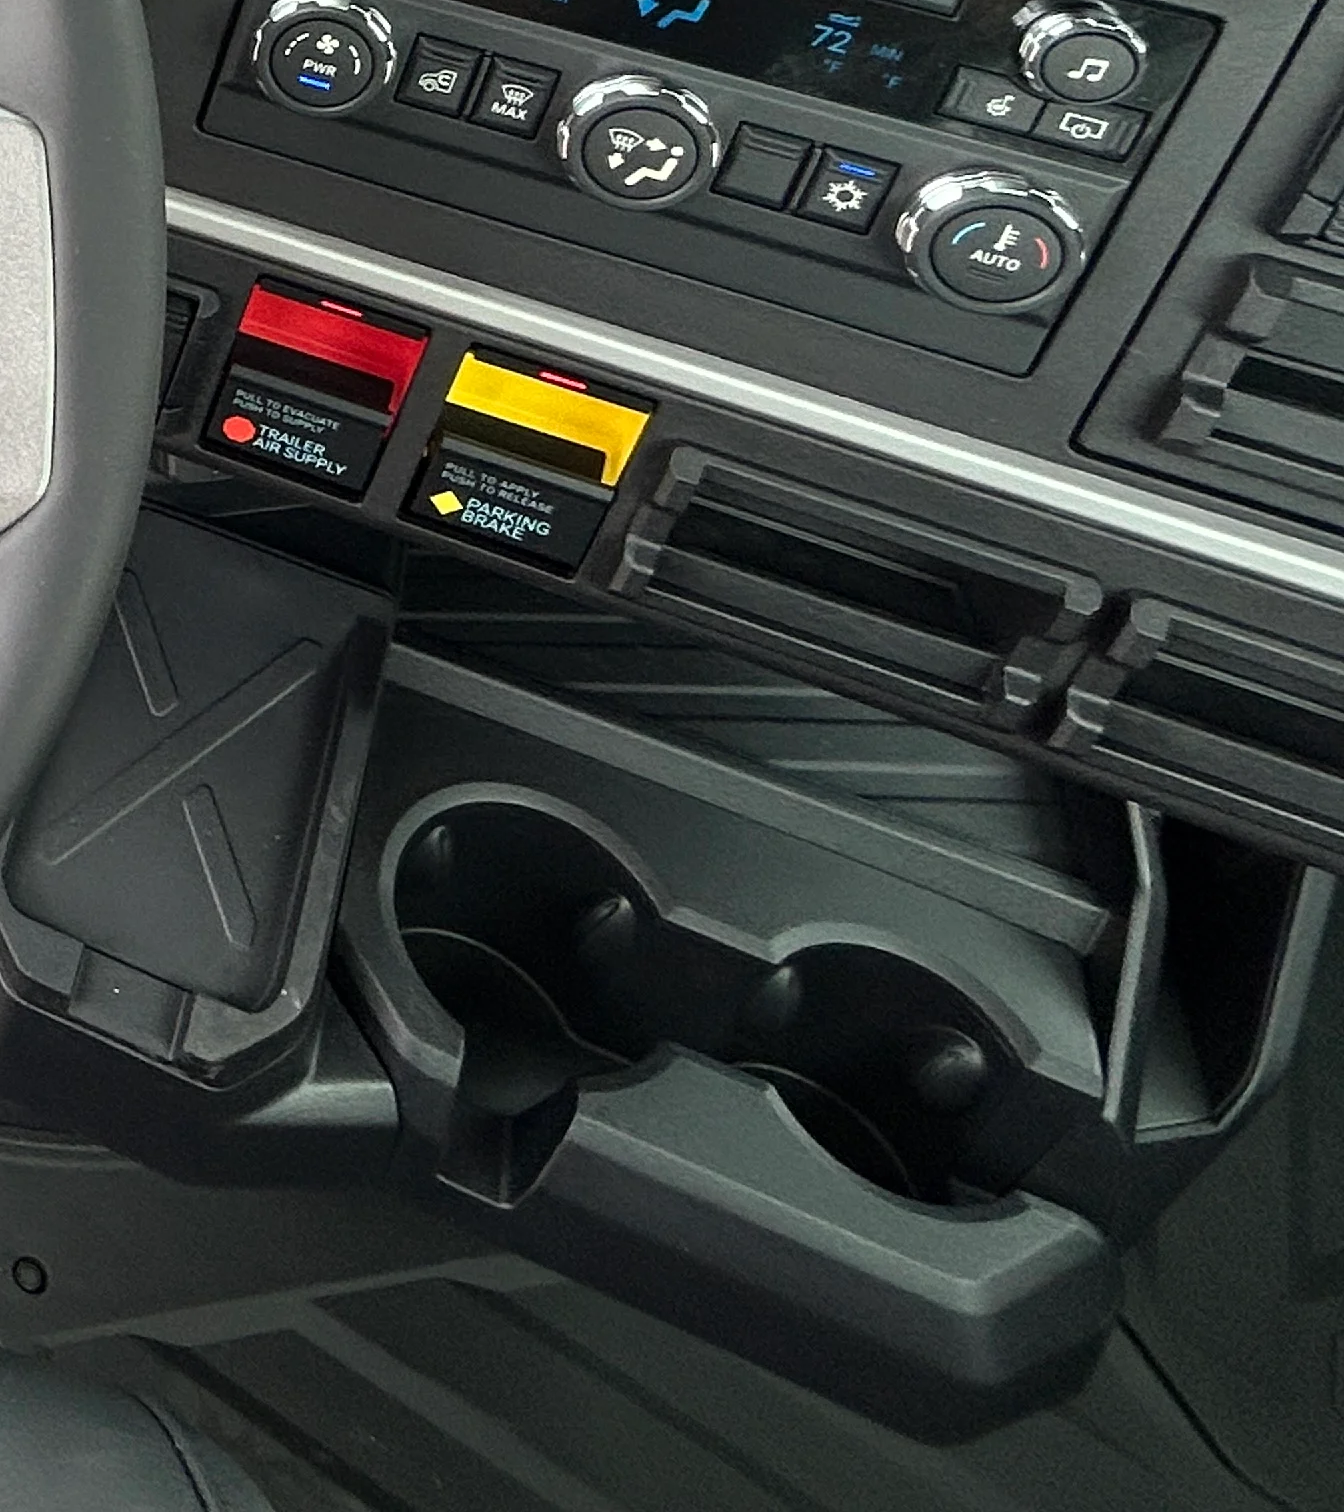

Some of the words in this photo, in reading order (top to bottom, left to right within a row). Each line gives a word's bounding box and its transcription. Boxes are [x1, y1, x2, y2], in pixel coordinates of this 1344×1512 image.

[811, 23, 852, 55] 72
[302, 58, 338, 78] PWR
[491, 101, 528, 121] MAX
[968, 248, 1023, 272] AUTO
[236, 388, 264, 405] PULL
[266, 398, 282, 411] TO
[282, 404, 341, 431] EVACUATE
[266, 408, 281, 420] TO
[259, 423, 327, 457] TRAILER
[252, 436, 282, 456] AIR
[282, 447, 348, 476] SUPPLY
[480, 472, 497, 485] TO
[480, 482, 496, 496] TO
[460, 510, 527, 542] BRAKE
[466, 496, 552, 537] PARKING
